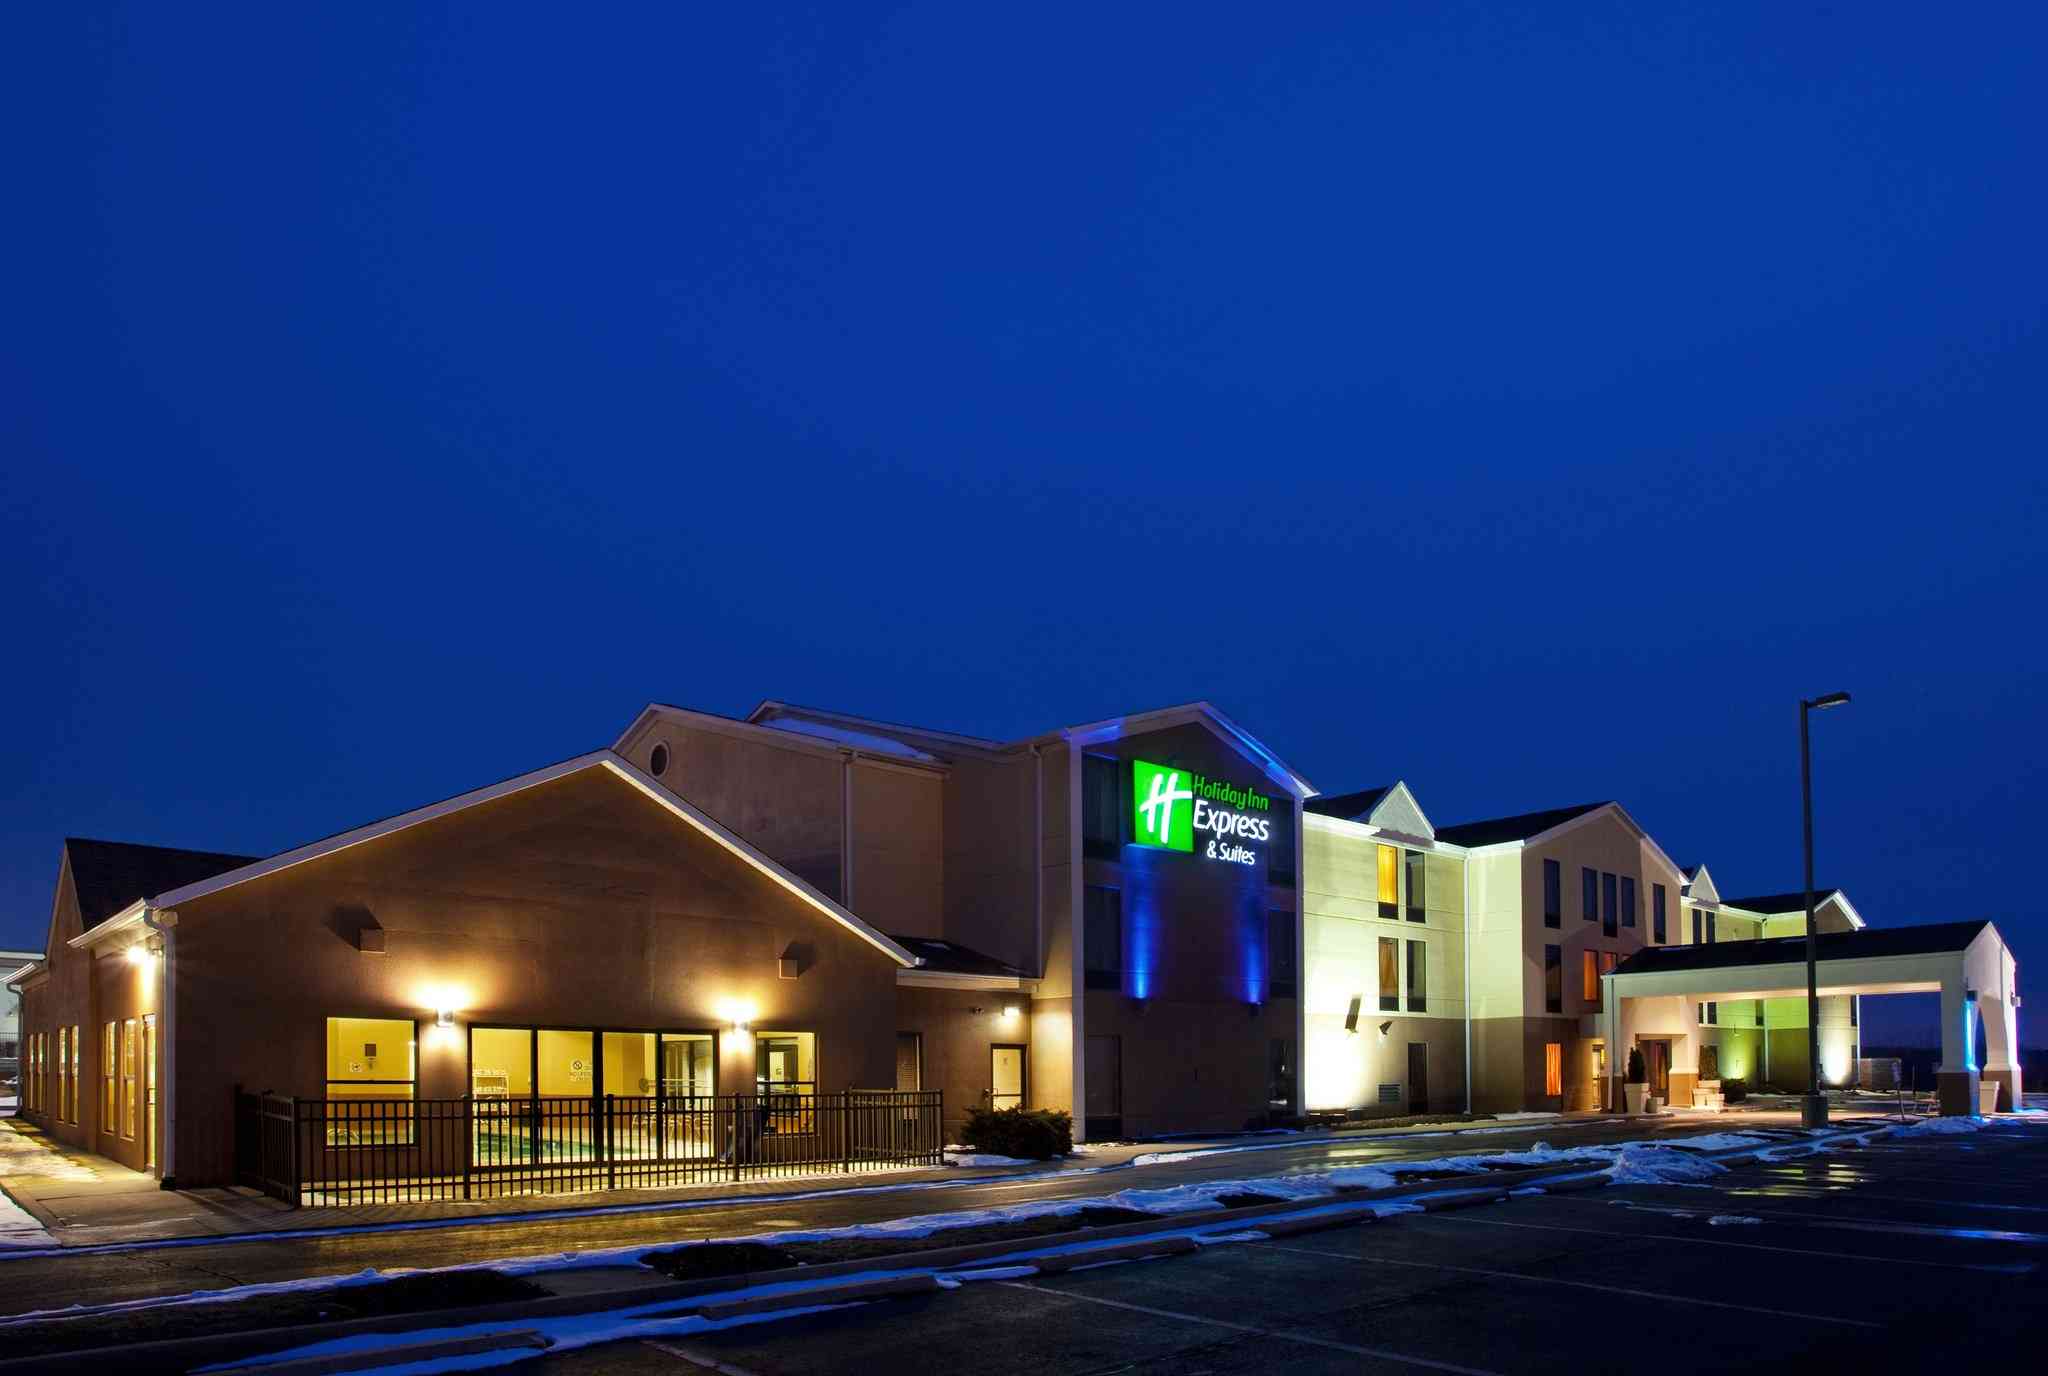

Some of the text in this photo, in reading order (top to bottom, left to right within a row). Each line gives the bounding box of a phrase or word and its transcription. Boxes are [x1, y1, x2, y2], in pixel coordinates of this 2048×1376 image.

[1193, 774, 1269, 811] Holiday Inn
[1192, 799, 1270, 841] Express
[1206, 840, 1256, 866] & Suites
